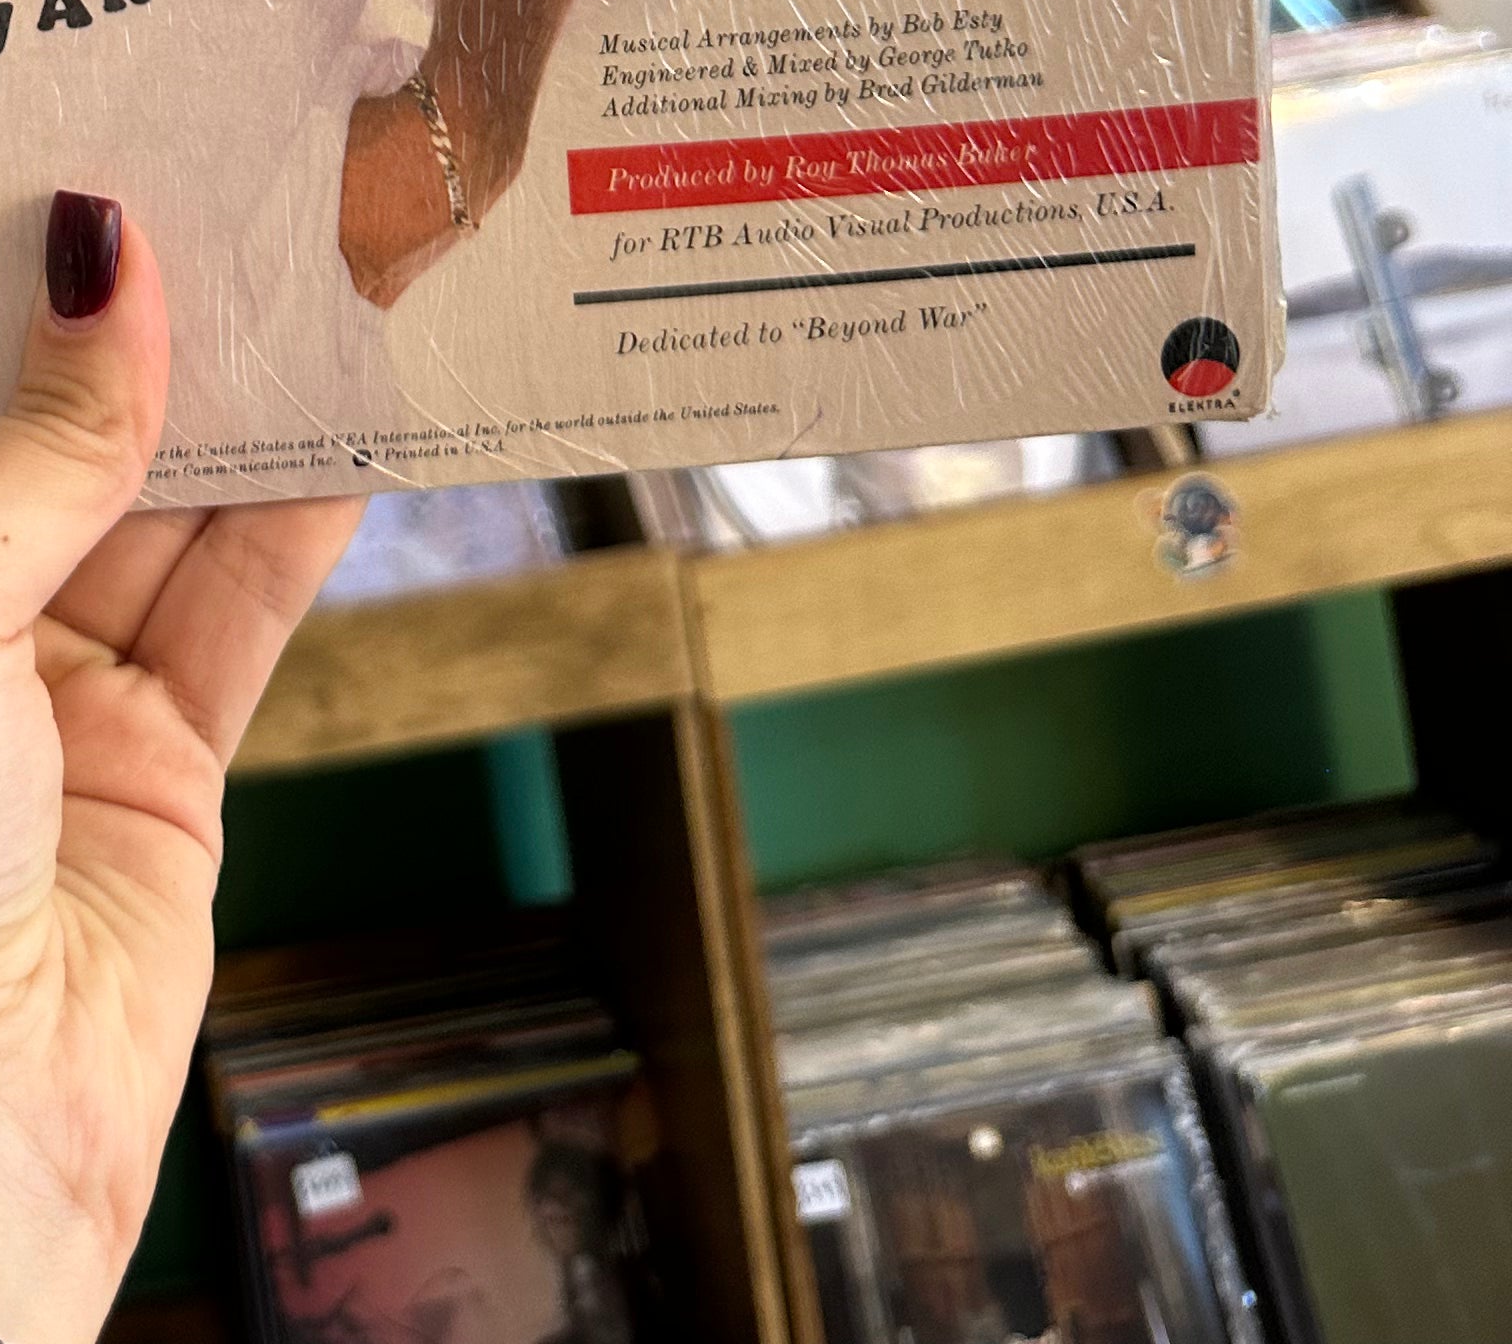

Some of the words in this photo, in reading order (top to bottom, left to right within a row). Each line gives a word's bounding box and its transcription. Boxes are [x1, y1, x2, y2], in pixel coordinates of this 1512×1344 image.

[599, 29, 690, 55] Musical
[696, 21, 861, 50] Arrangements
[869, 16, 894, 41] by
[903, 11, 944, 34] Bob
[952, 9, 1003, 31] Esty
[600, 58, 734, 89] Engineered
[742, 56, 759, 77] &
[767, 50, 837, 75] Mixed
[845, 49, 871, 72] by
[878, 46, 955, 68] George
[963, 38, 1029, 61] Tutko
[601, 89, 727, 117] Additional
[735, 85, 818, 109] Mixing
[824, 82, 850, 105] by
[858, 76, 913, 100] Brad
[921, 72, 1044, 95] Gilderman
[608, 160, 734, 192] Produced
[743, 159, 775, 186] by
[785, 155, 837, 182] Roy
[845, 147, 948, 174] Thomas
[957, 141, 1039, 165] Baker
[610, 232, 652, 261] for
[660, 224, 724, 251] RTB
[732, 218, 816, 246] Audio
[826, 206, 911, 238] Visual
[919, 199, 1084, 232] Productions,
[616, 322, 750, 354] Dedicated
[759, 322, 783, 343] to
[1168, 398, 1236, 412] ELEKTRA
[169, 443, 191, 460] the
[196, 440, 246, 458] United
[251, 439, 294, 453] States
[298, 435, 325, 450] and
[373, 423, 470, 444] International
[505, 419, 525, 436] for
[529, 417, 551, 432] the
[554, 414, 594, 430] world
[597, 410, 649, 427] outside
[653, 408, 675, 422] the
[680, 404, 730, 421] United
[733, 401, 780, 416] States.
[146, 465, 178, 481] rner
[384, 442, 440, 462] Printed
[444, 441, 460, 456] in
